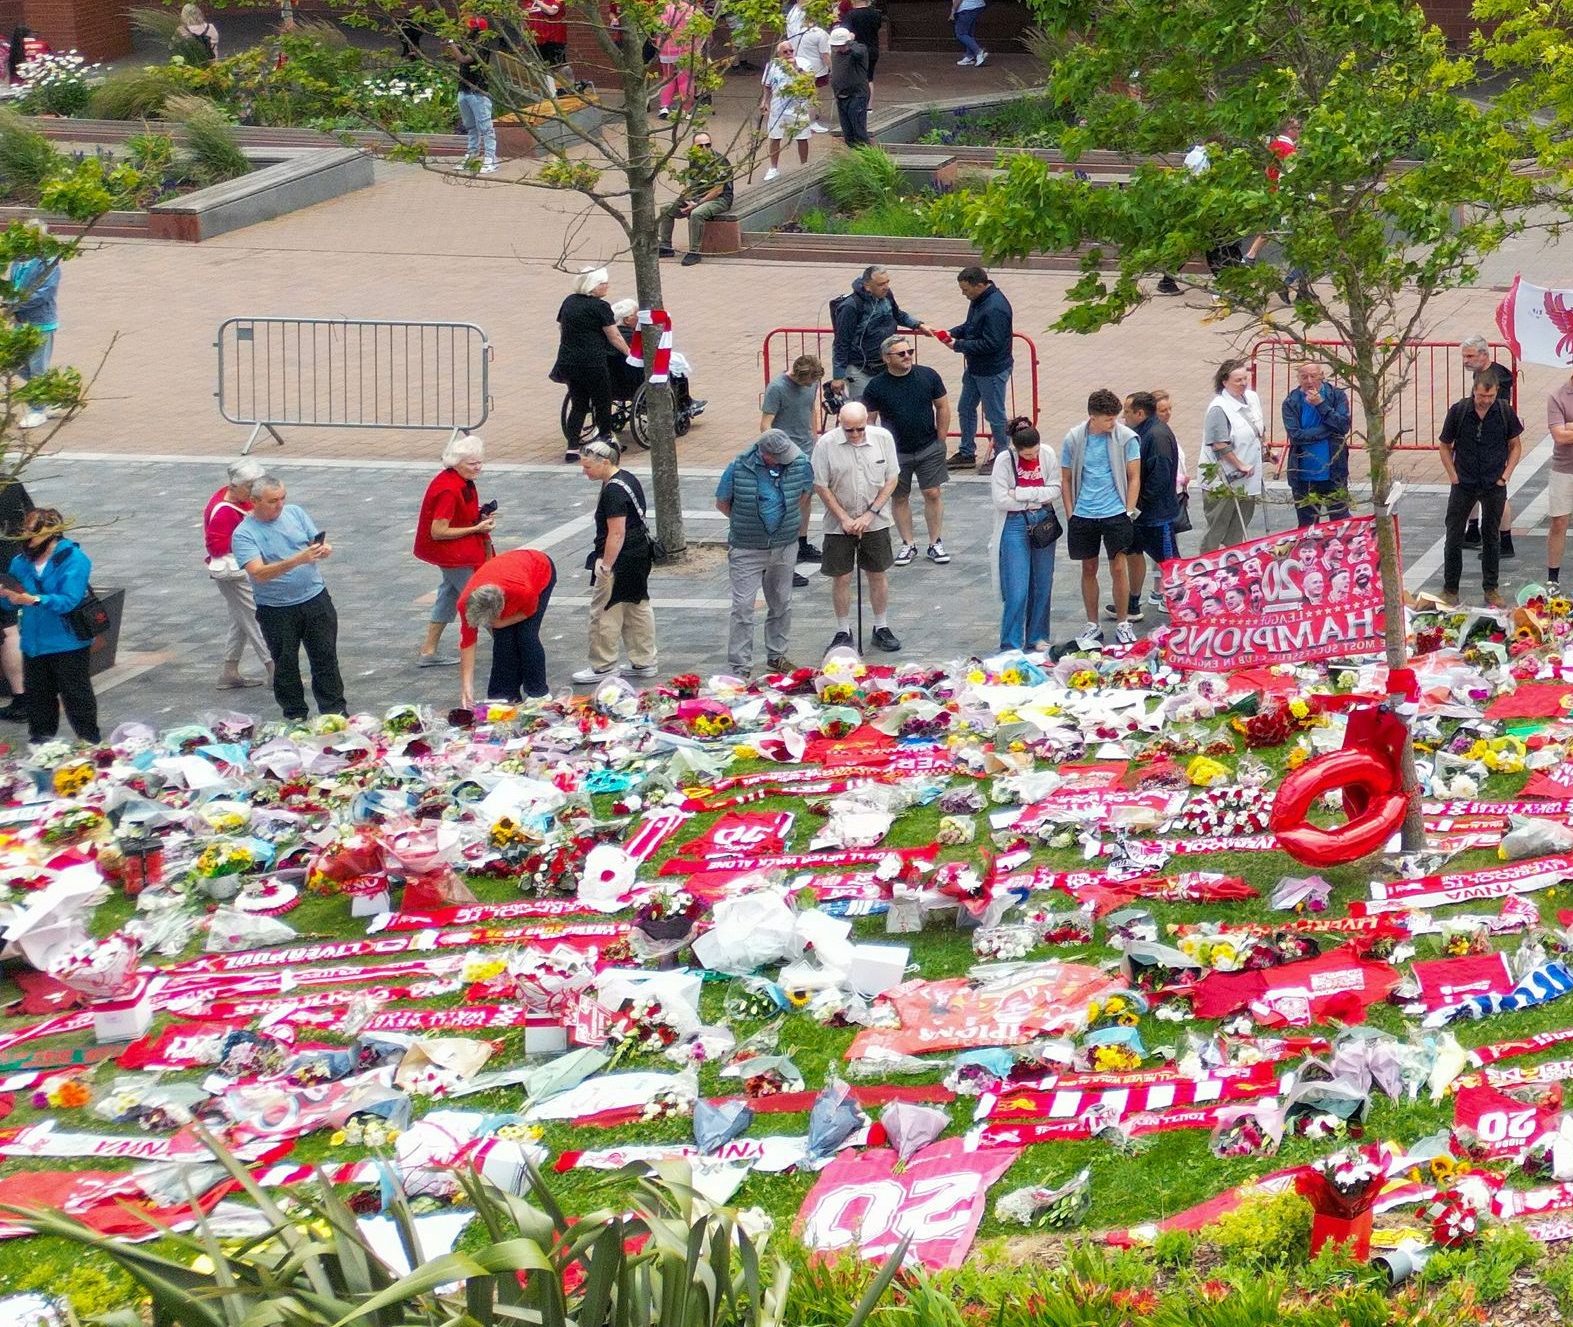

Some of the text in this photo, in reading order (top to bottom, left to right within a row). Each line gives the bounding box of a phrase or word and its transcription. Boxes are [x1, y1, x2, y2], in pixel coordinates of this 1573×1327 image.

[1180, 835, 1278, 853] IVERPOOL
[706, 859, 753, 871] ALONE
[757, 856, 798, 869] WALK
[800, 853, 846, 864] NEVER
[1445, 883, 1520, 901] YNWA
[223, 942, 361, 971] LIVERPOOL
[1477, 1110, 1536, 1141] 20
[804, 1170, 986, 1250] 20
